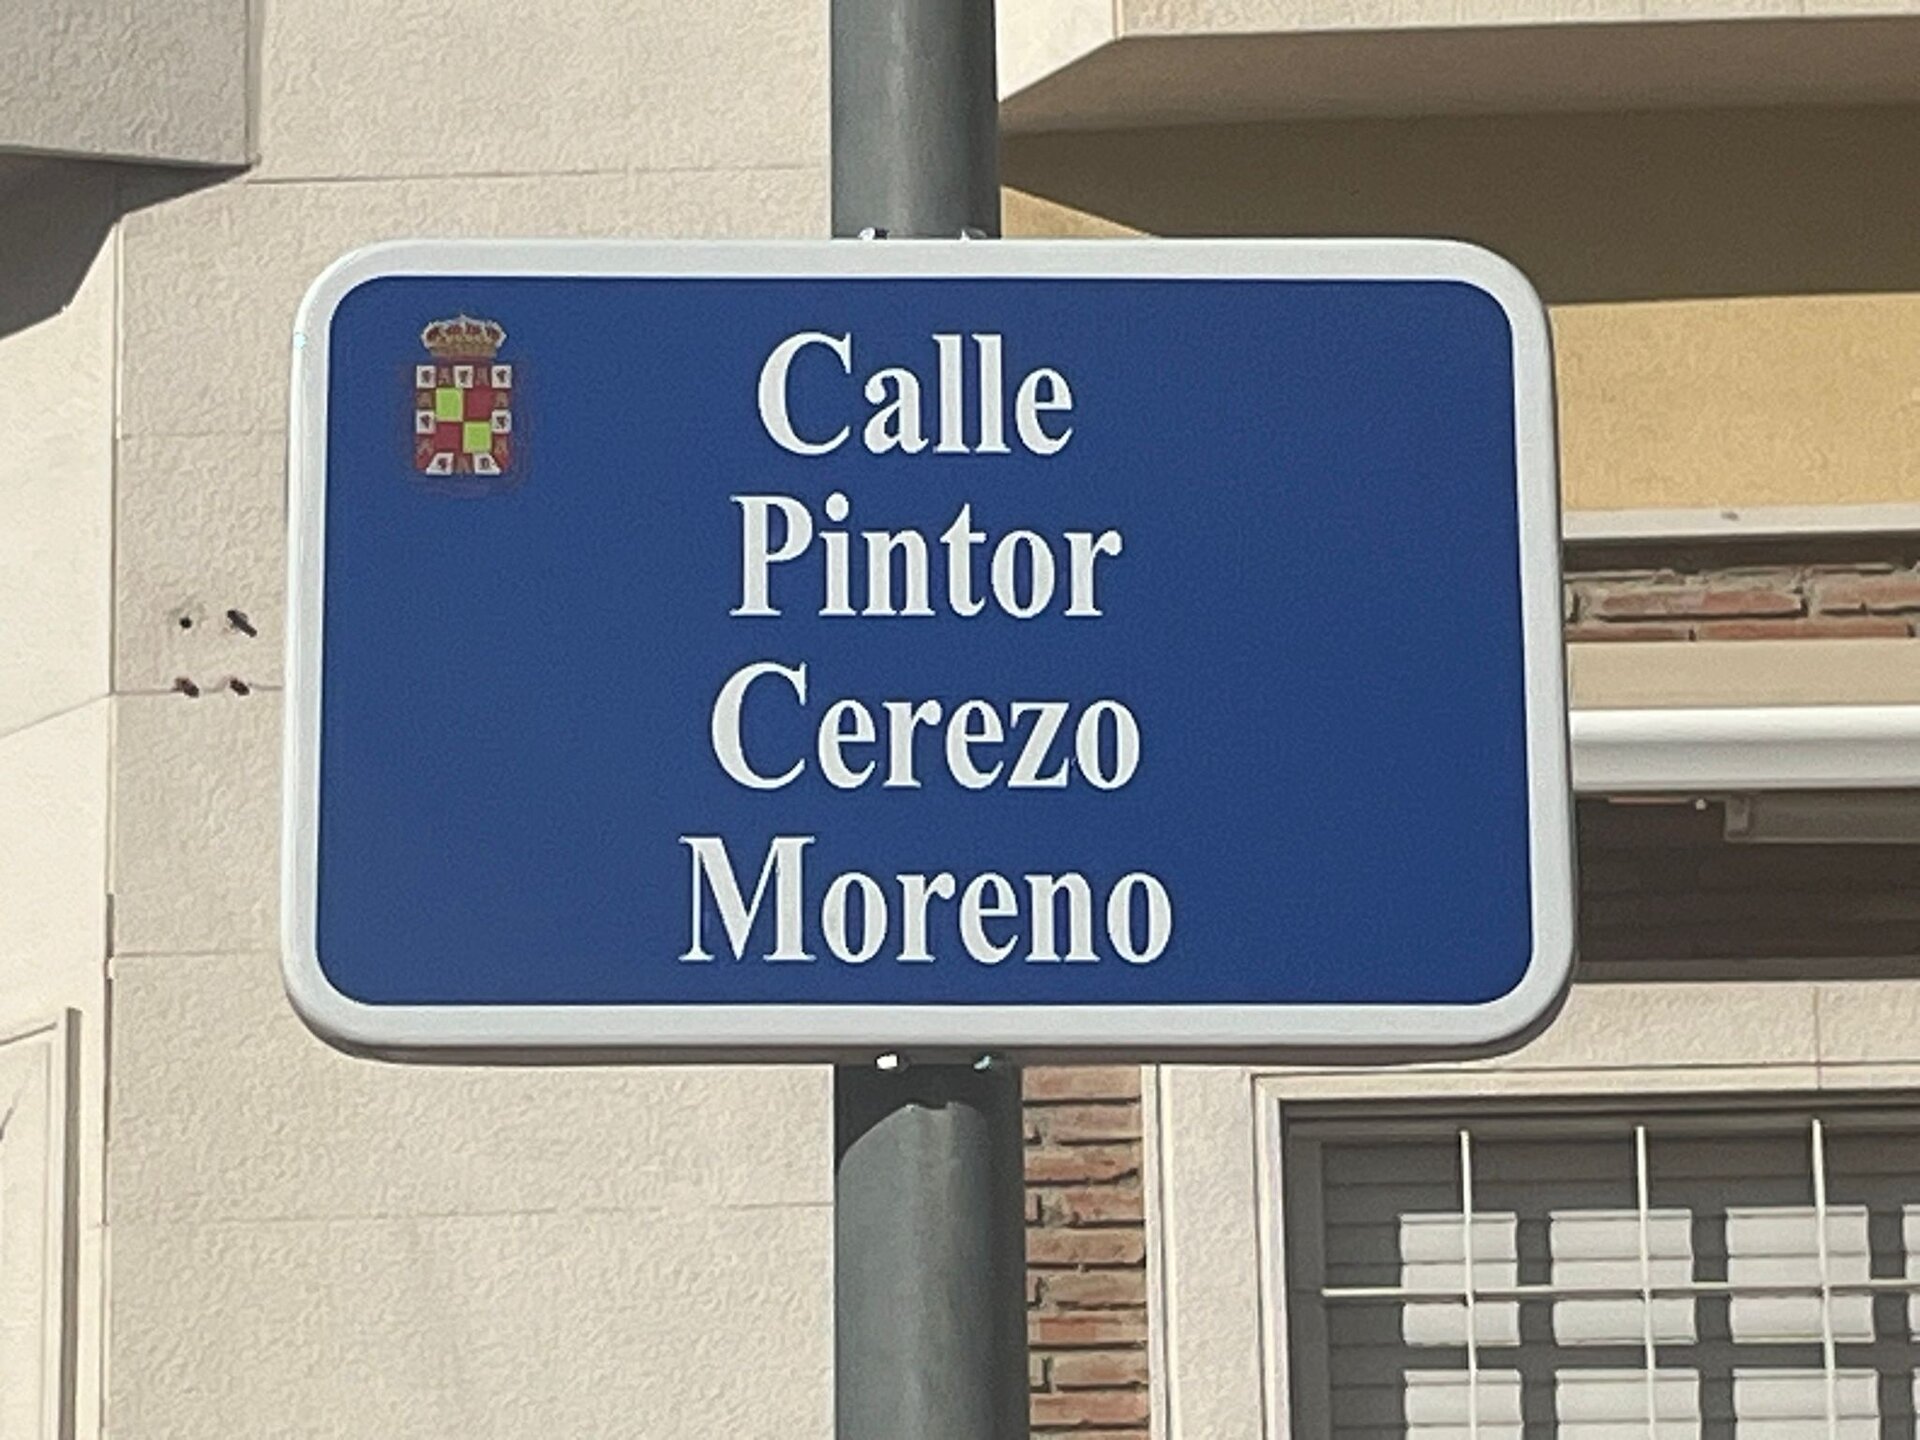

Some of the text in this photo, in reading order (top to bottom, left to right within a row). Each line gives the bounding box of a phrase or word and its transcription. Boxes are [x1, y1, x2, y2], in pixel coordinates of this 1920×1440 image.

[757, 331, 1074, 456] Calle
[729, 491, 1123, 619] Pintor
[711, 661, 1141, 791] Cerezo
[678, 835, 1173, 965] Moreno
